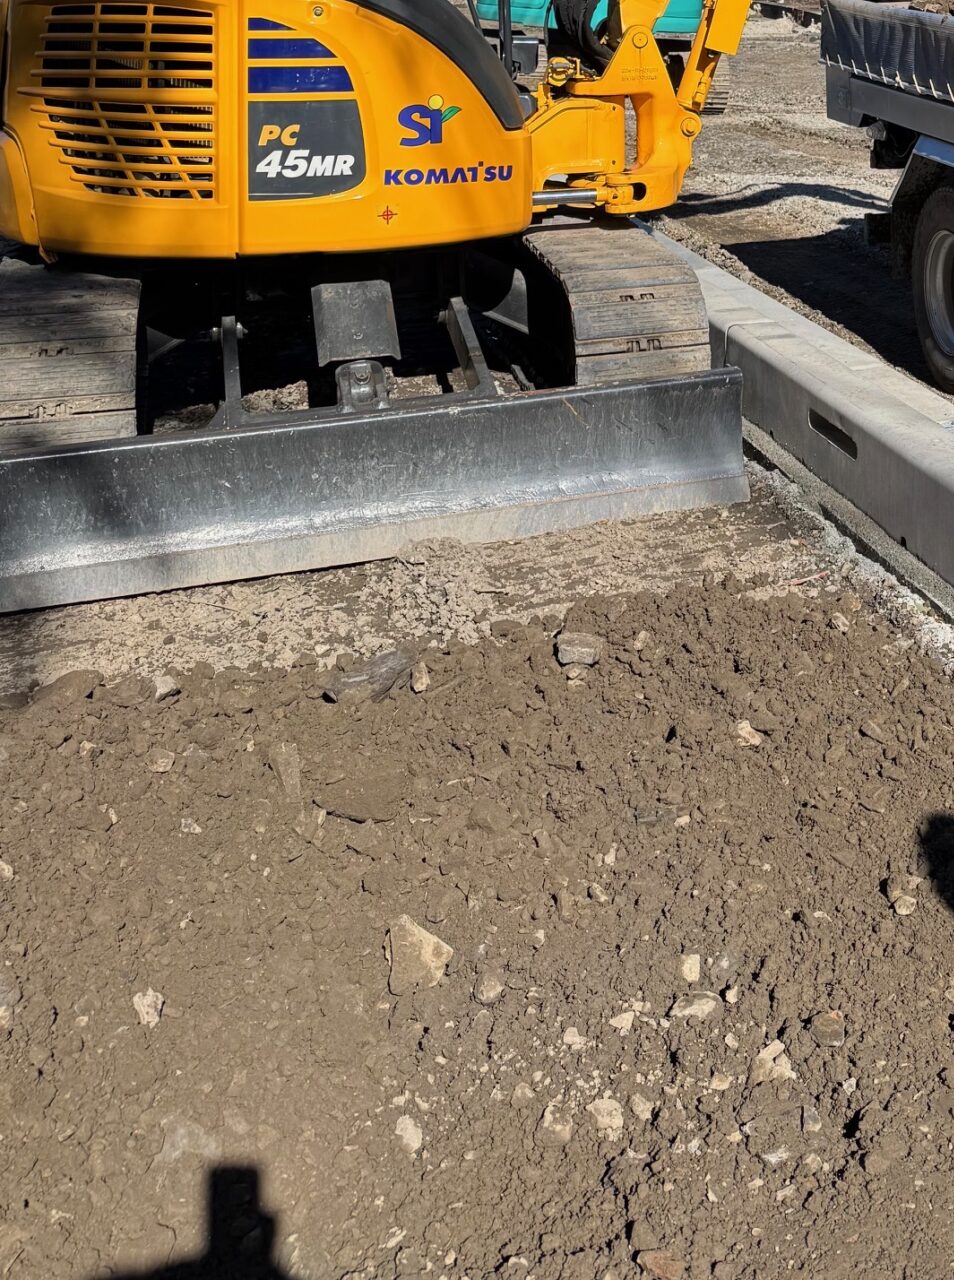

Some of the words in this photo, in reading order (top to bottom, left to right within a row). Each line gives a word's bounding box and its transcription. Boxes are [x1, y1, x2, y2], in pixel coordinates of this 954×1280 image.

[258, 124, 300, 146] PC
[255, 149, 355, 178] 45MR
[384, 161, 513, 186] KOMATSU
